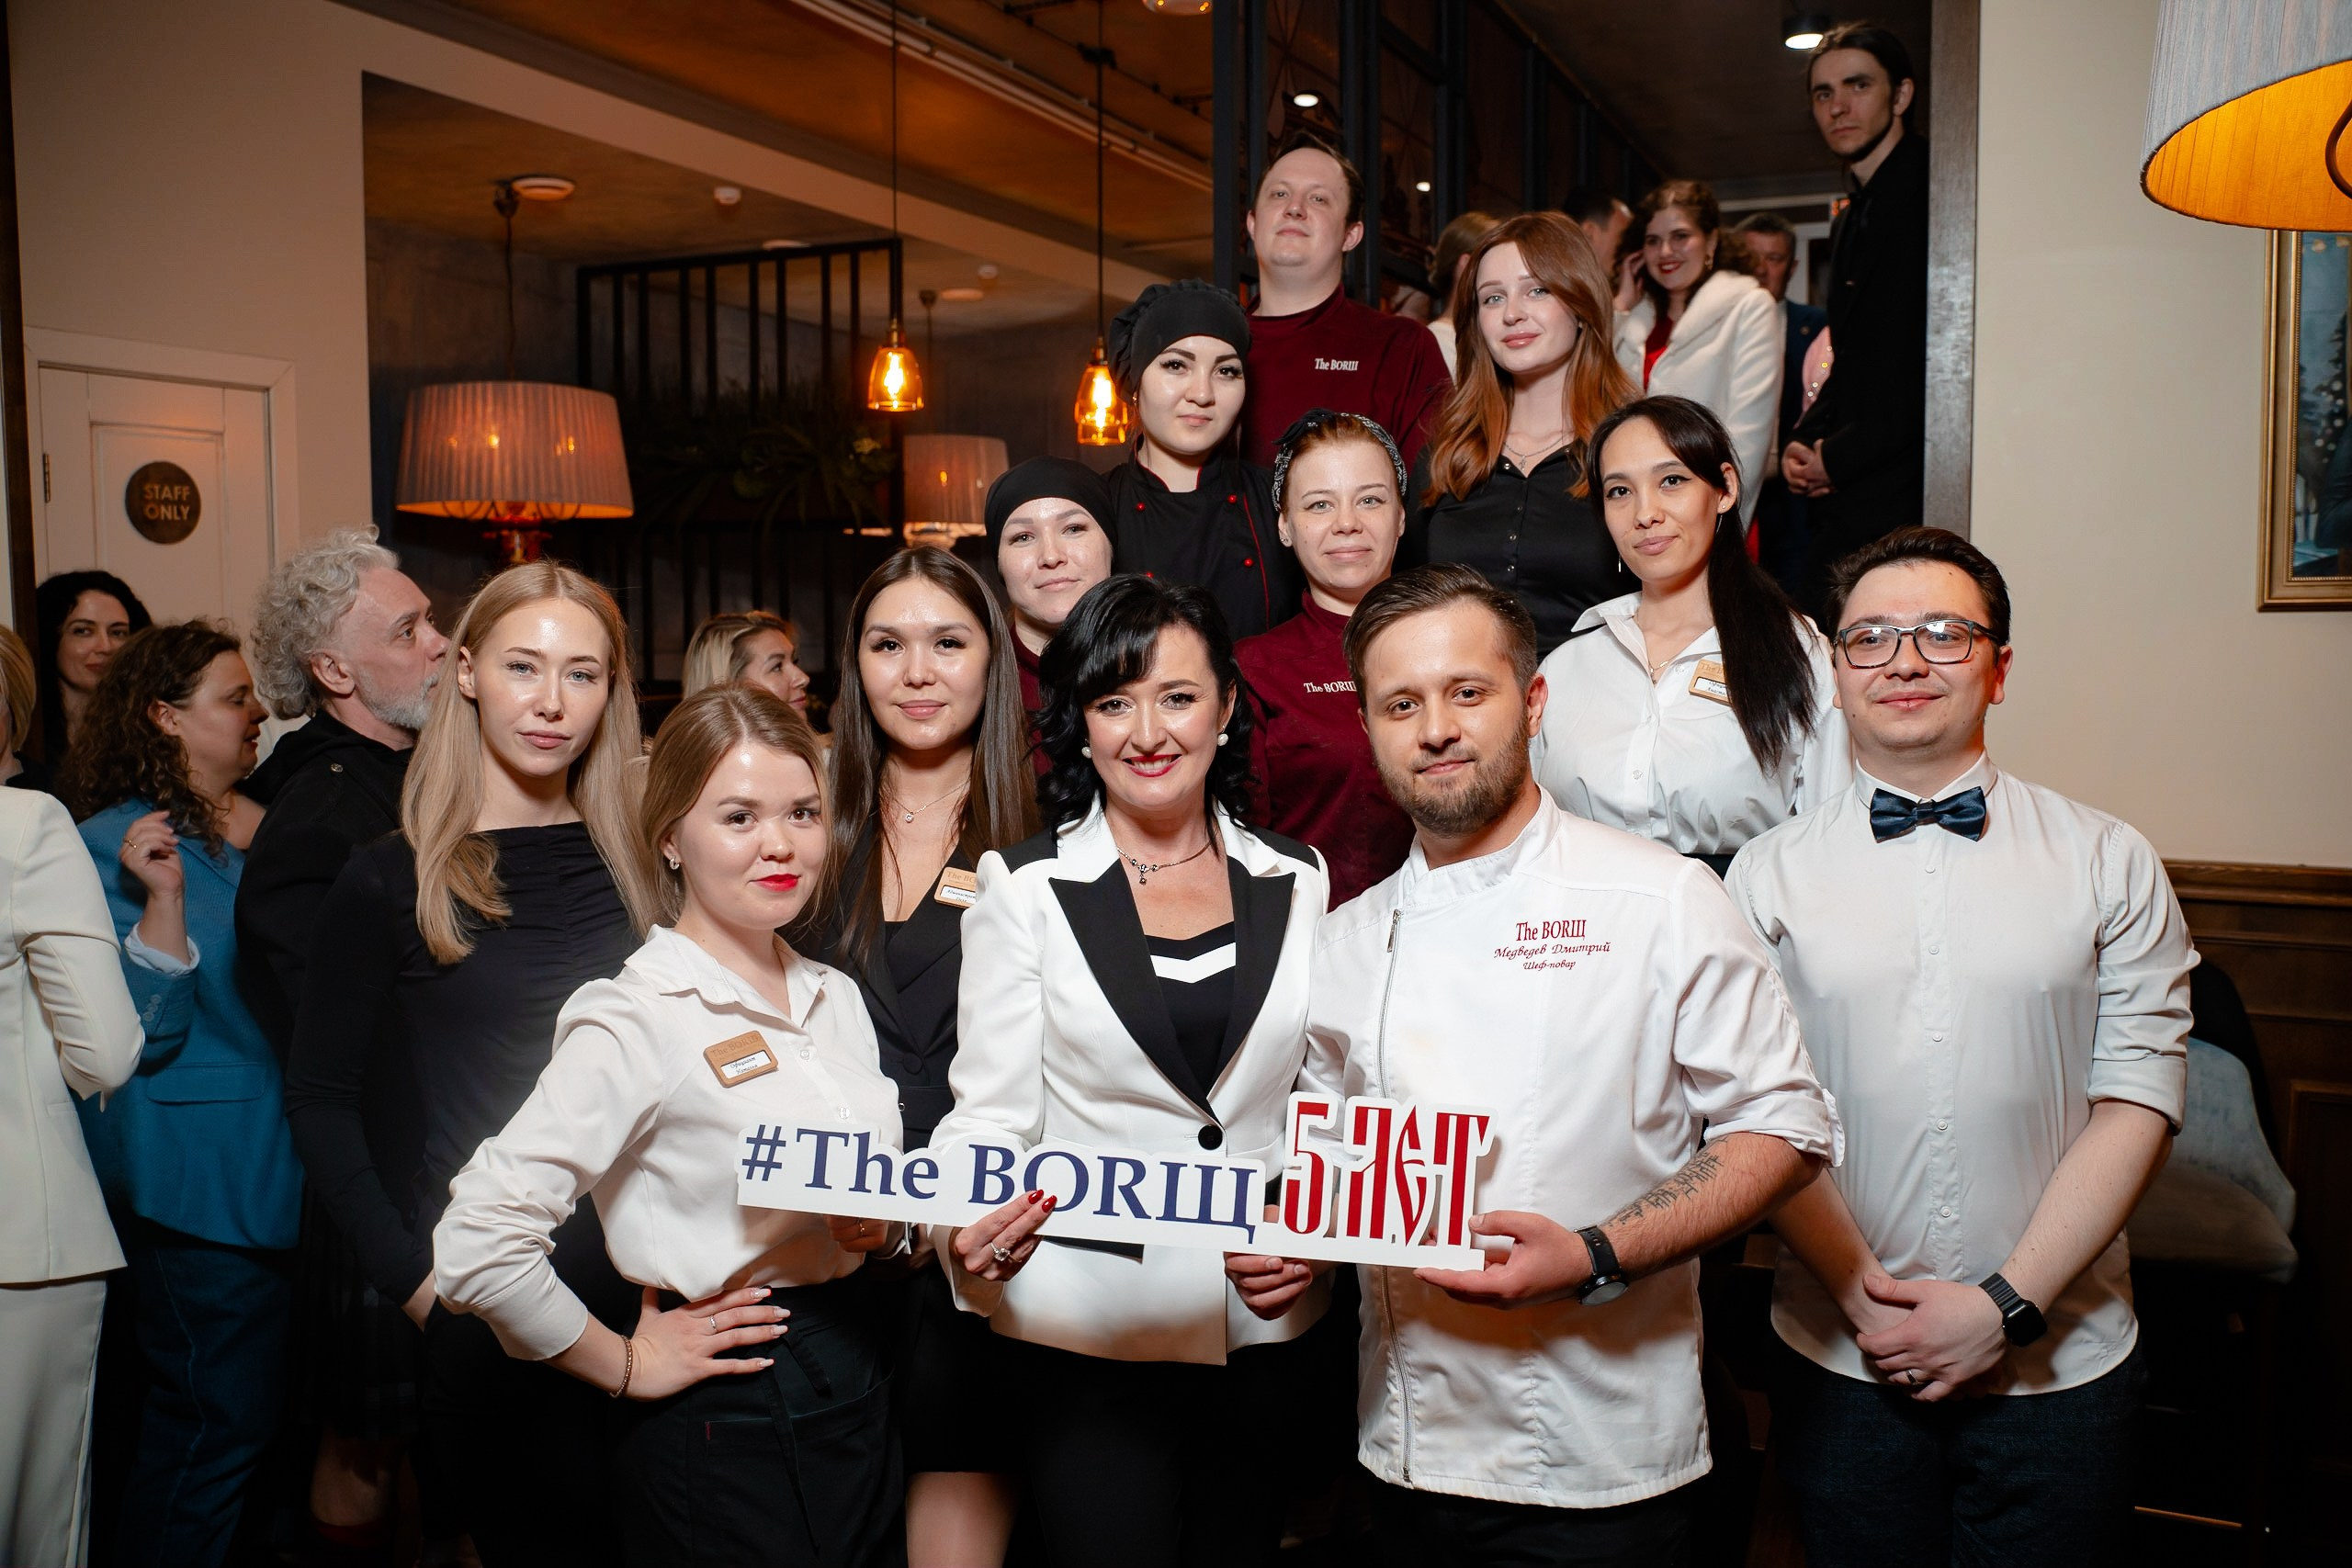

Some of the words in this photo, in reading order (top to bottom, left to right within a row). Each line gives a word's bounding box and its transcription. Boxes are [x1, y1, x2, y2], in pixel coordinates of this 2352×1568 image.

[1315, 357, 1329, 370] The
[143, 484, 190, 501] STAFF
[144, 504, 189, 521] ONLY
[1304, 682, 1323, 693] The
[1516, 921, 1538, 941] The
[1542, 919, 1587, 941] BORЩ
[1494, 944, 1547, 960] Медведев
[1552, 942, 1611, 955] Дмитрий
[1523, 959, 1576, 971] Шеф-повар
[742, 1123, 940, 1200] #The
[967, 1144, 1258, 1245] BORЩ
[1283, 1100, 1329, 1235] 5
